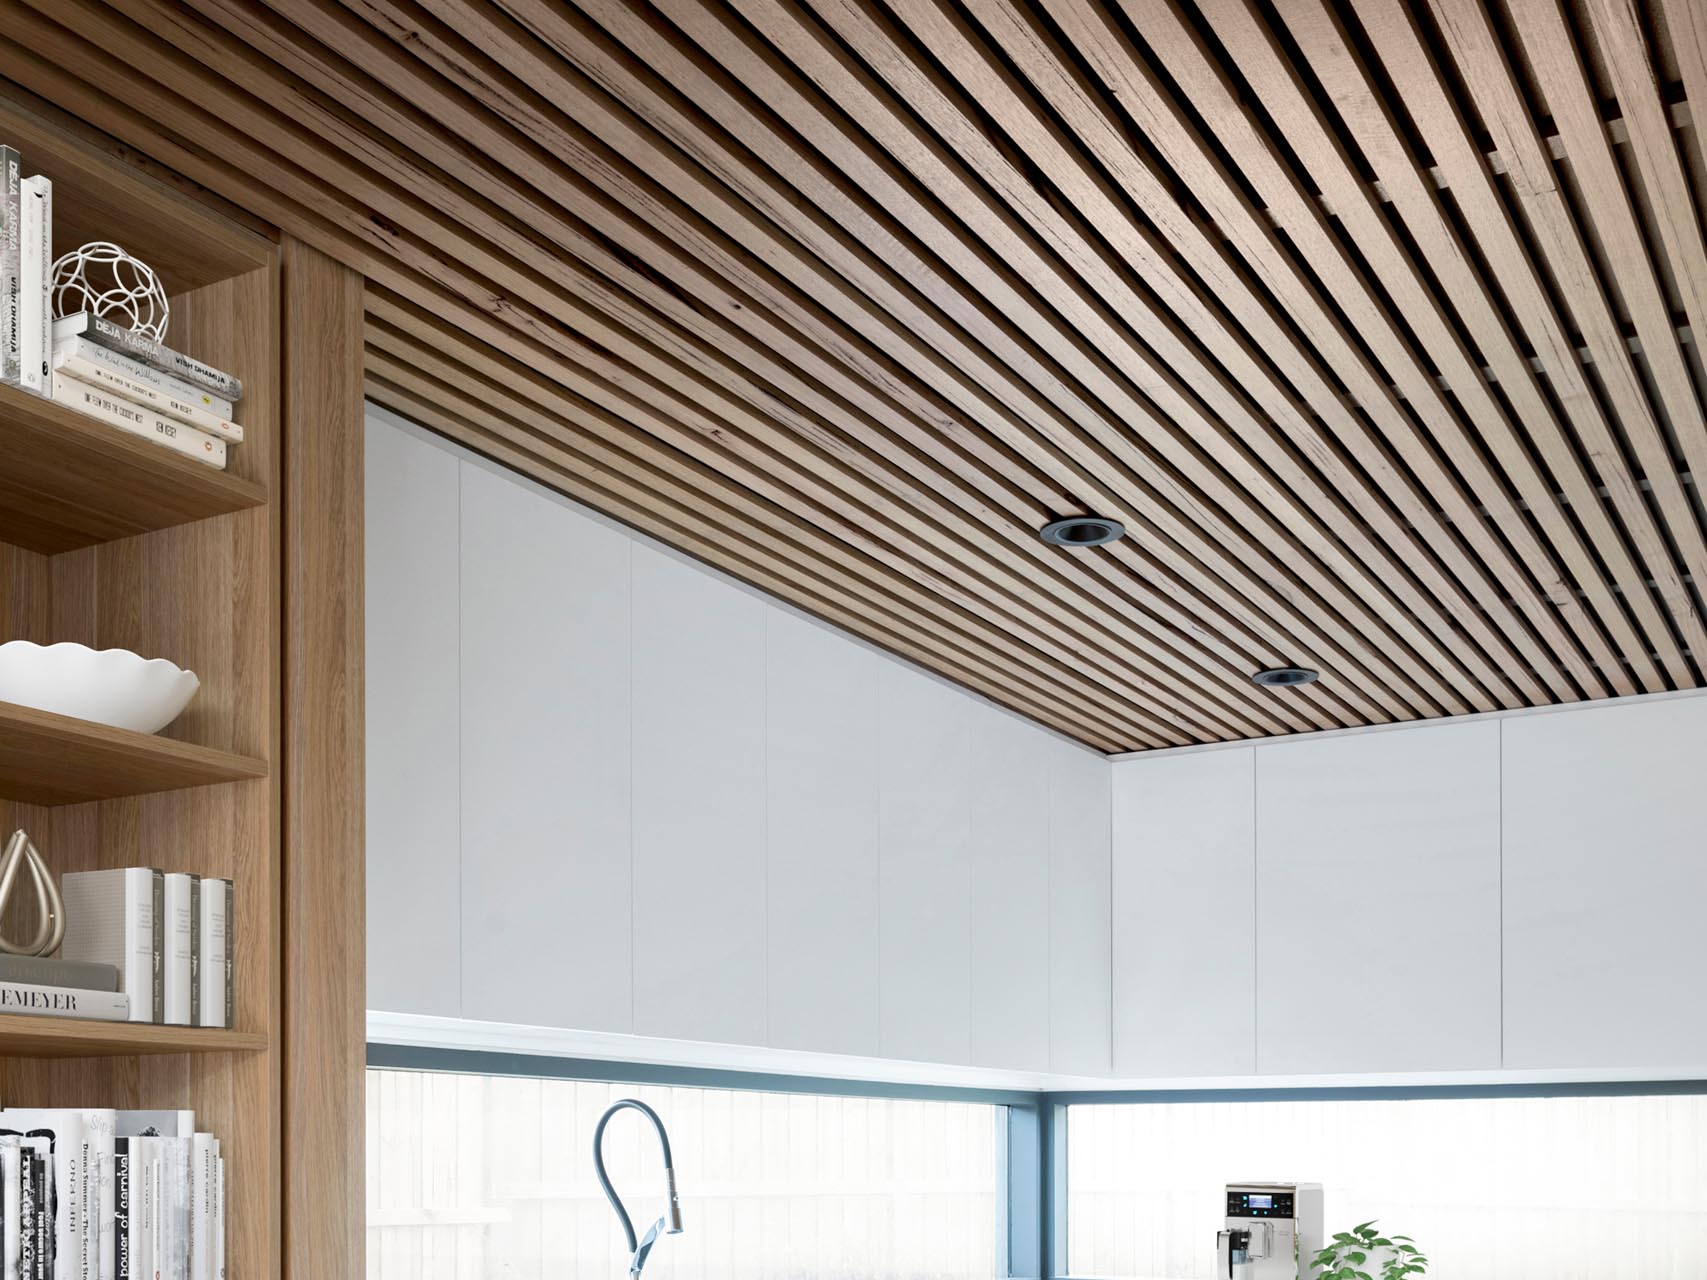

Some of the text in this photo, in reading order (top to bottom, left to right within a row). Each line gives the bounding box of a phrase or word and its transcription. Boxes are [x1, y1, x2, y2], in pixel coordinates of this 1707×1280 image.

[8, 200, 18, 251] KARMA
[123, 332, 159, 355] KARMA
[175, 357, 226, 384] VISH DHAMIJA
[22, 1155, 32, 1227] APPEAL
[115, 1153, 128, 1207] carnival
[115, 1211, 128, 1229] of
[119, 1233, 128, 1277] power
